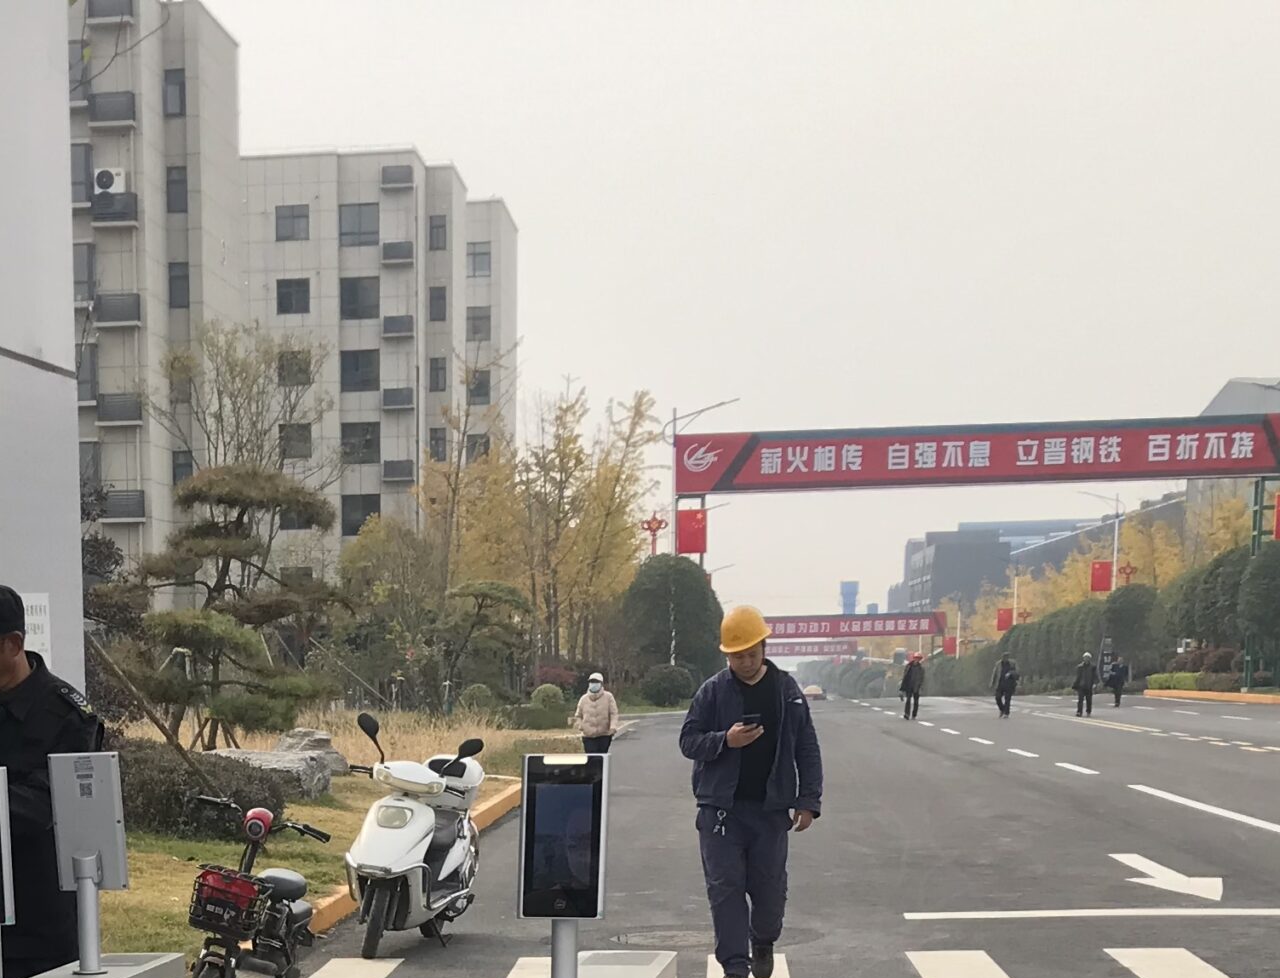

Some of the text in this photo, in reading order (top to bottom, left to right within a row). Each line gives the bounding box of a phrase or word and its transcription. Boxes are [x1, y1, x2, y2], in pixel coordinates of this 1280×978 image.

[760, 431, 1255, 475] 薪火相传 自强不息 立晋钢铁 百折不挠
